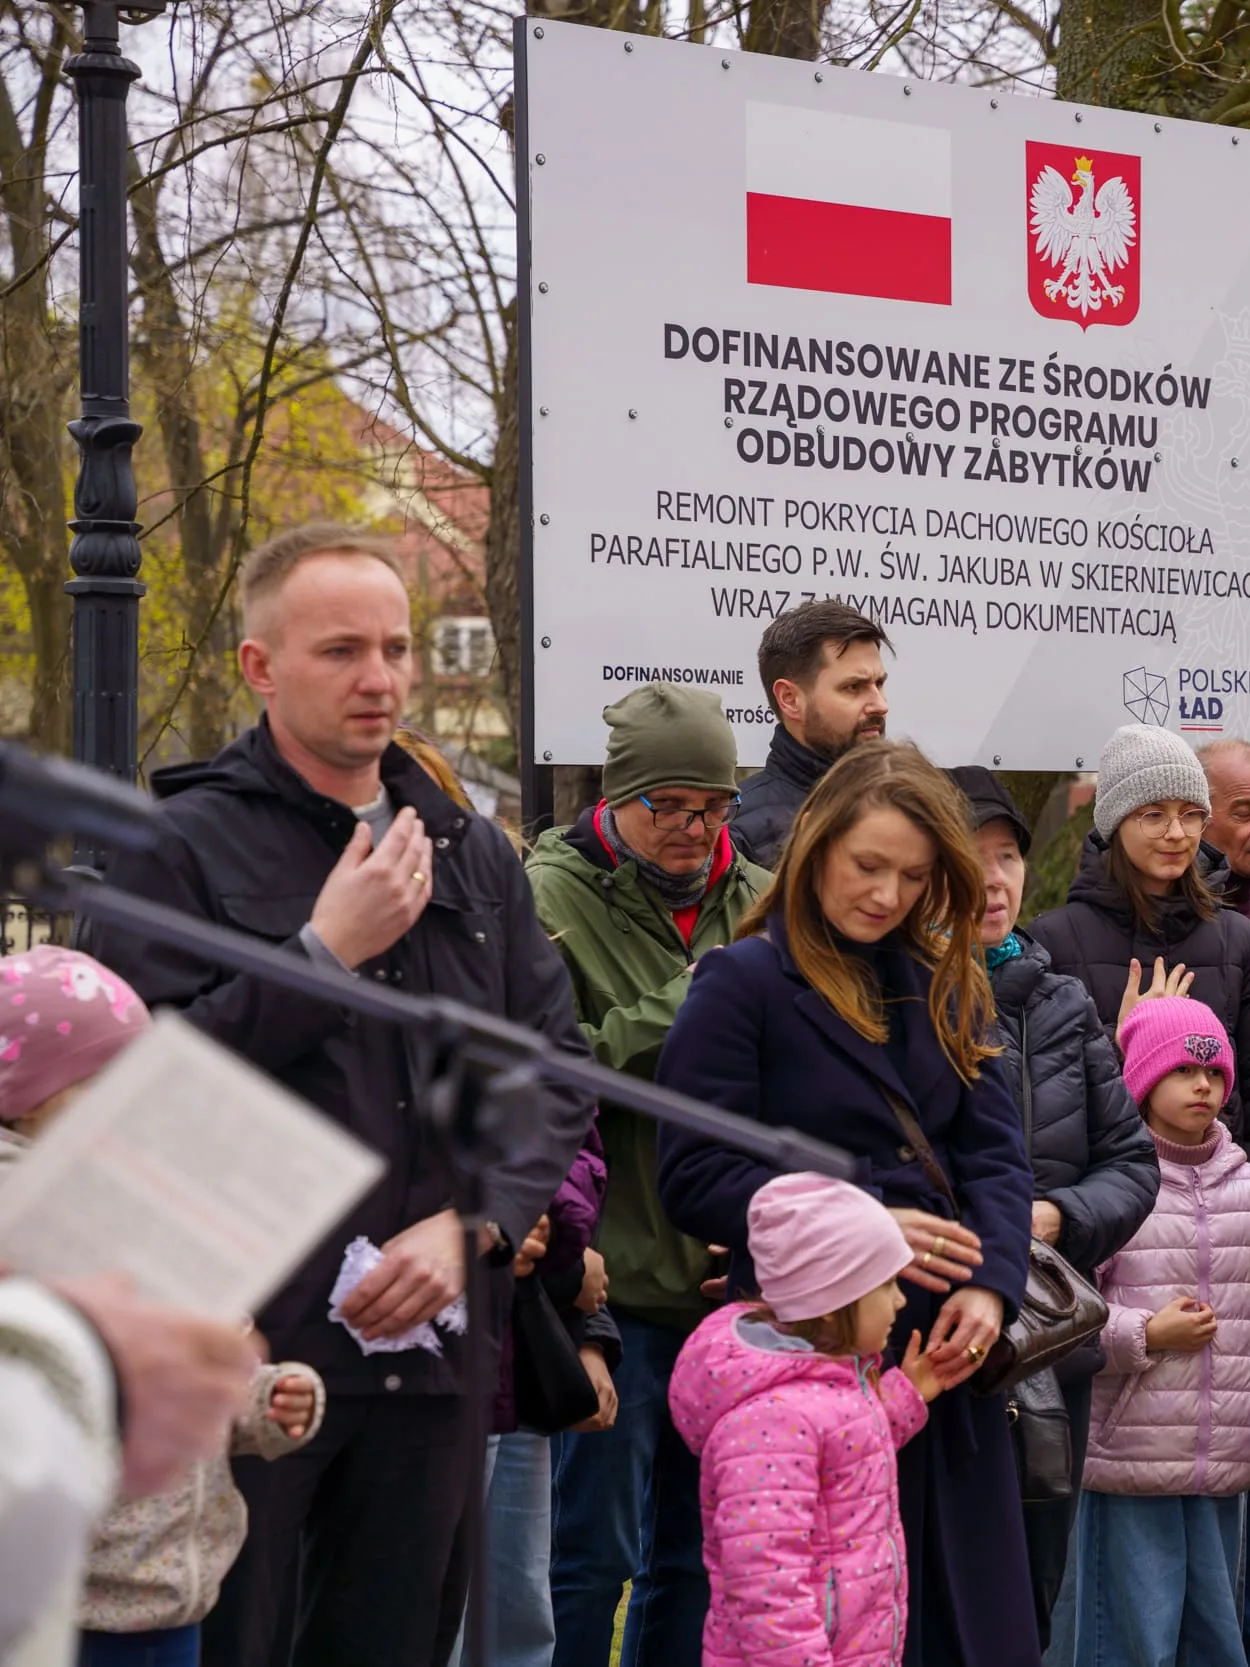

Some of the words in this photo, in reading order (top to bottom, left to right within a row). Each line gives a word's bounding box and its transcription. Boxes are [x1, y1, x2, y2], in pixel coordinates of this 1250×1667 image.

[663, 323, 990, 390] DOFINANSOWANE
[998, 357, 1035, 393] ZE
[1042, 351, 1211, 410] ŚRODKÓW
[724, 377, 961, 432] RZĄDOWEGO
[969, 399, 1158, 449] PROGRAMU
[736, 427, 956, 479] ODBUDOWY
[963, 444, 1152, 493] ZABYTKÓW
[656, 489, 775, 526] REMONT
[784, 498, 917, 536] POKRYCIA
[926, 508, 1089, 547] DACHOWEGO
[1097, 513, 1215, 555] KOŚCIOŁA
[590, 533, 801, 575] PARAFIALNEGO
[812, 547, 870, 578] P.W.
[880, 542, 928, 582] ŚW.
[937, 554, 1032, 588] JAKUBA
[1039, 560, 1063, 589] W
[711, 586, 791, 619] WRAZ
[986, 600, 1177, 645] DOKUMENTACJĄ
[602, 666, 744, 685] DOFINANSOWANIE
[726, 706, 775, 724] RTOŚĆ
[1179, 696, 1224, 720] ŁAD
